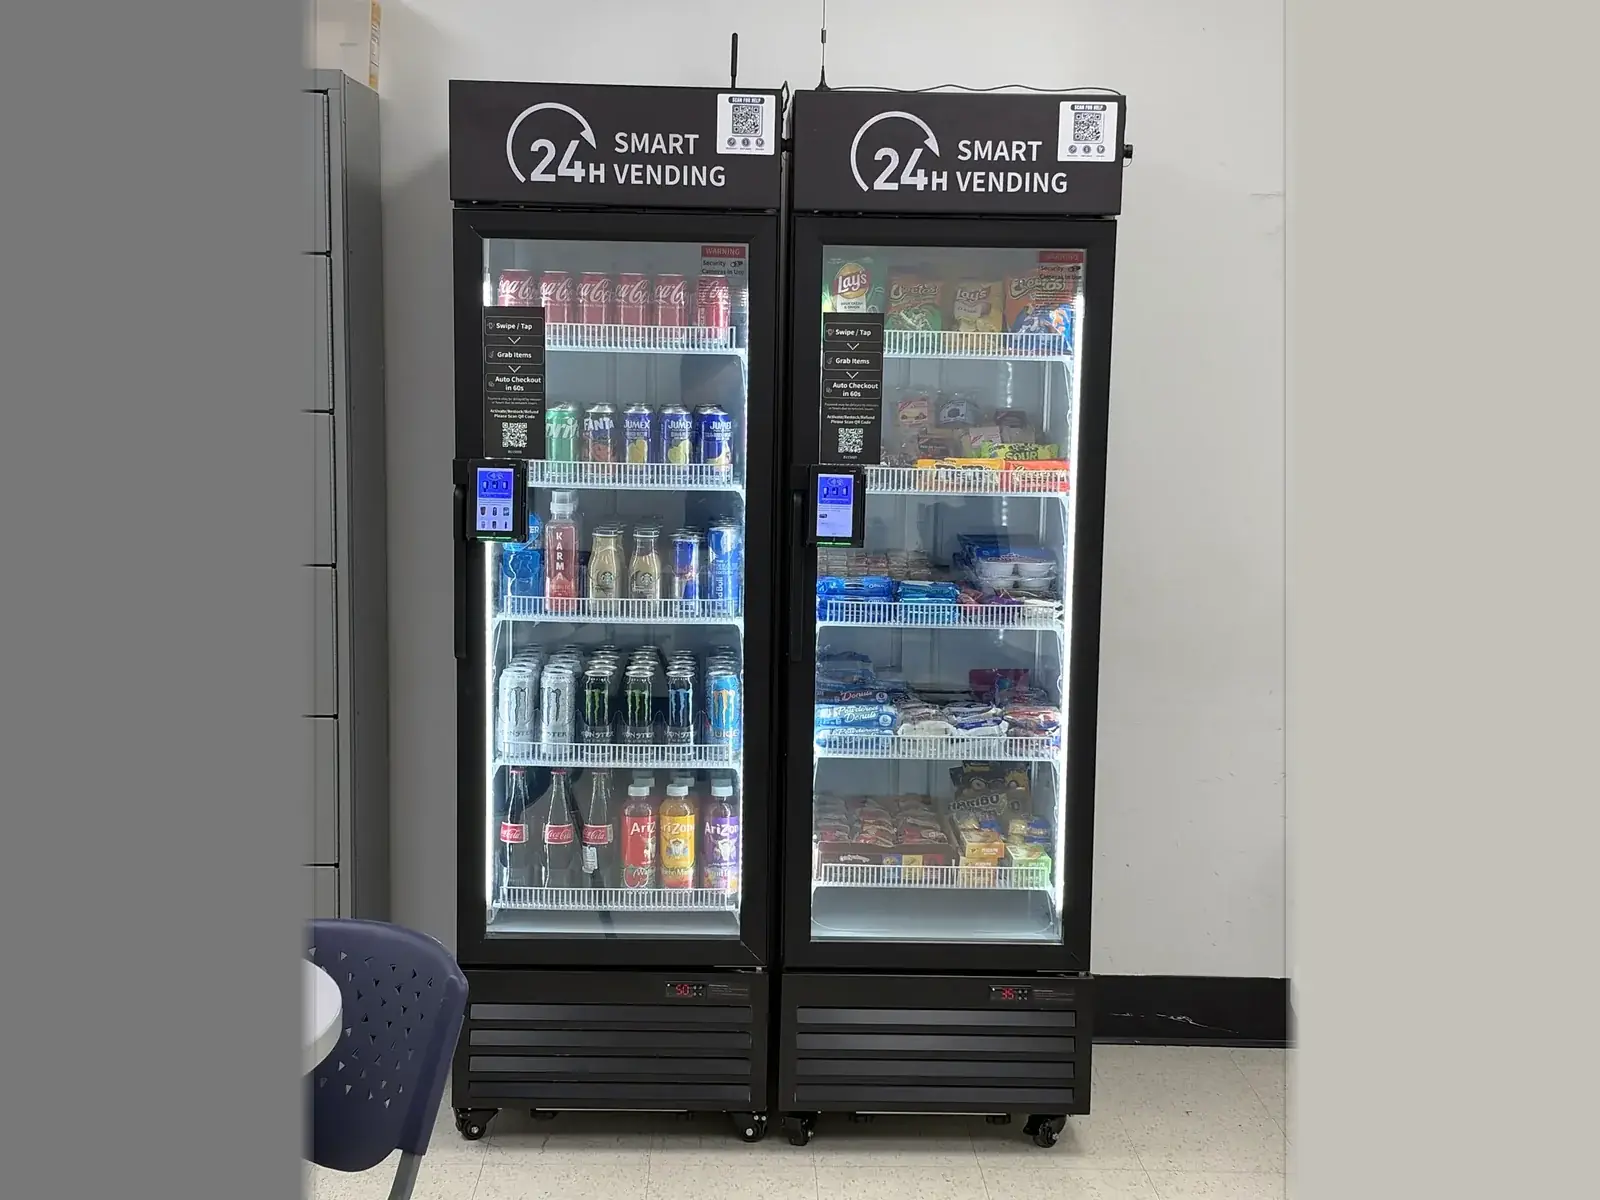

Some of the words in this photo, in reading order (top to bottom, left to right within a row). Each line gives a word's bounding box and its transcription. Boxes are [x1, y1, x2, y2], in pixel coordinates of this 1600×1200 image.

[614, 131, 699, 154] SMART
[957, 139, 1042, 162] SMART
[530, 138, 605, 183] 24H
[613, 163, 726, 187] VENDING
[873, 146, 948, 191] 24H
[956, 170, 1068, 193] VENDING
[705, 247, 740, 255] WARNING
[837, 272, 867, 294] Lay's
[956, 288, 989, 302] Lay's
[496, 322, 516, 330] Swipe
[835, 328, 855, 337] Swipe
[859, 329, 872, 337] Tap
[583, 416, 614, 431] FANTA
[623, 418, 651, 429] JUMEX
[709, 420, 732, 430] JUME
[1004, 450, 1039, 460] SOUR
[555, 532, 565, 580] KARMA
[840, 690, 872, 701] Donuts
[836, 705, 879, 716] Powdered
[843, 712, 877, 723] Donuts
[630, 821, 657, 836] AriZ
[704, 821, 739, 837] AriZon
